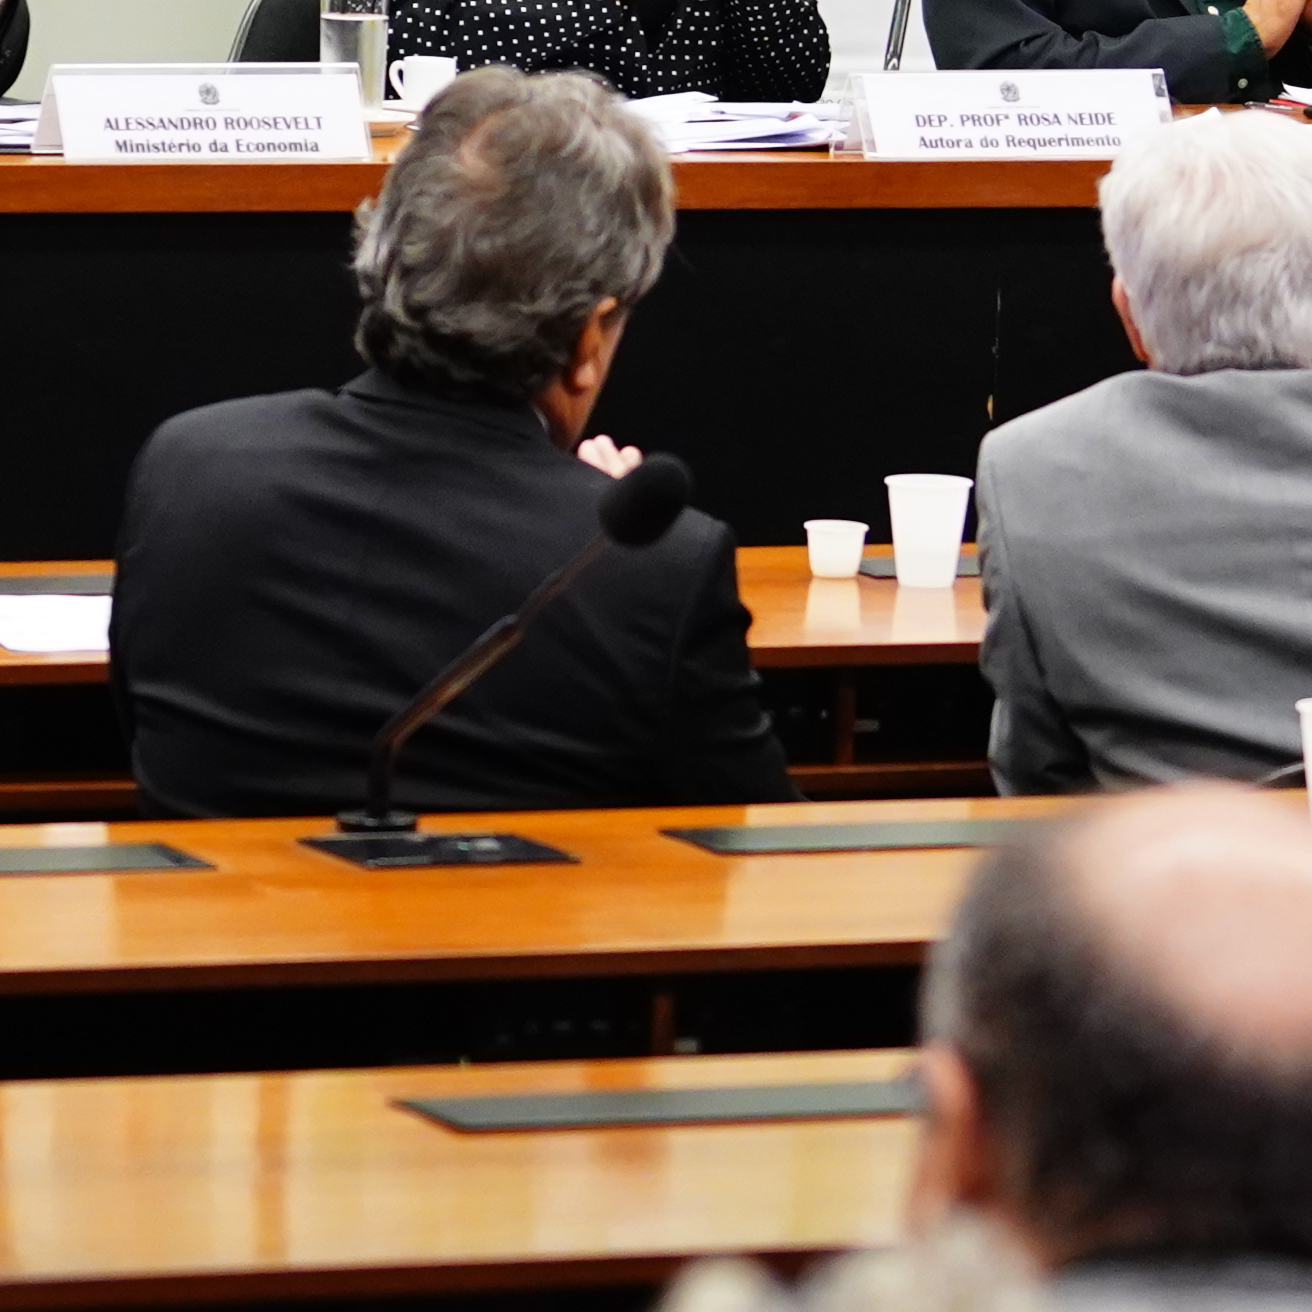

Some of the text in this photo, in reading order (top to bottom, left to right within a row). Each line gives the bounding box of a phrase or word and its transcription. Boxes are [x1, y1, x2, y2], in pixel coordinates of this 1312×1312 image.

[104, 116, 322, 132] ALESSANDRO ROOSEVELT
[914, 114, 954, 128] DEP.
[1016, 112, 1063, 127] ROSA
[1066, 112, 1116, 126] NEIDE
[114, 138, 321, 154] Ministério da Economia
[918, 133, 1122, 151] Autora do Requerimento
